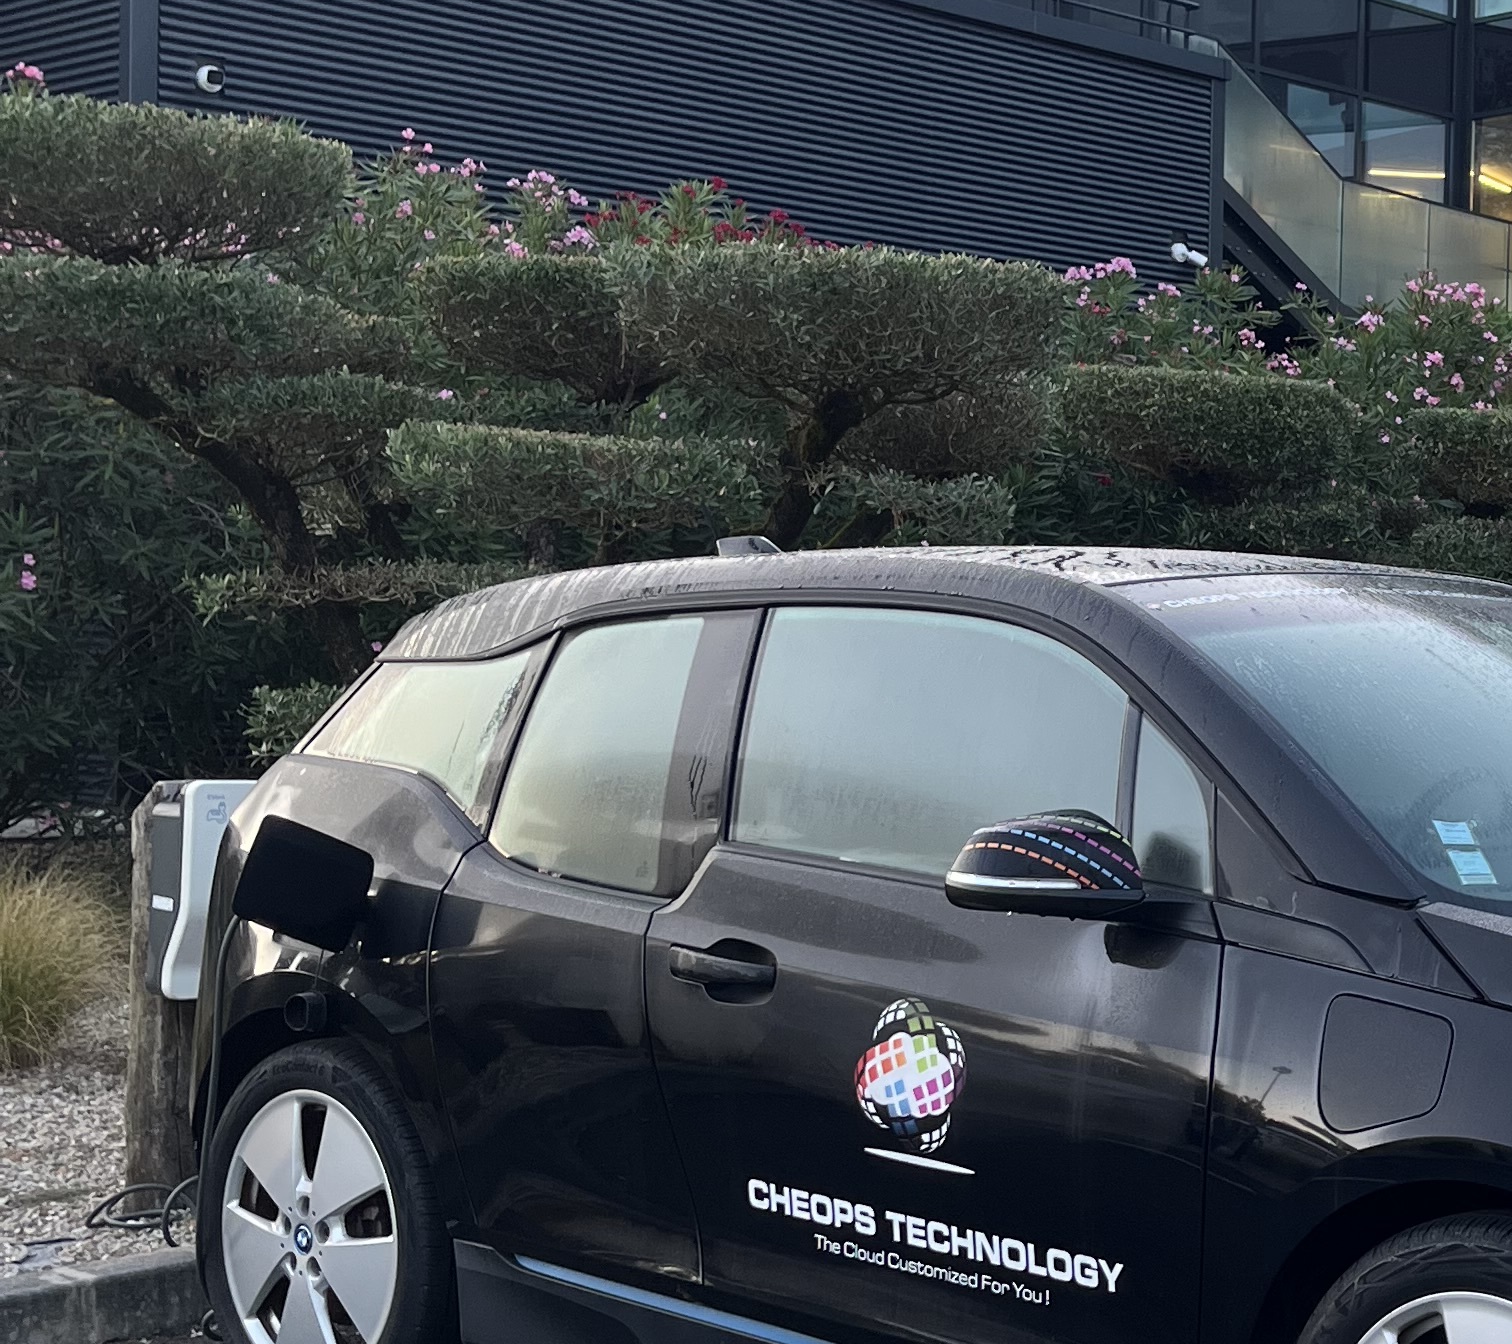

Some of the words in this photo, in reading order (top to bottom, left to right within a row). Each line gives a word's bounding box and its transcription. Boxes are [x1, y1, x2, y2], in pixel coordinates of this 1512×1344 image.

[747, 1178, 877, 1236] CHEOPS
[885, 1210, 1124, 1293] TECHNOLOGY
[814, 1233, 841, 1257] The
[843, 1241, 885, 1267] Cloud
[887, 1252, 979, 1289] Customized
[981, 1274, 1011, 1296] For
